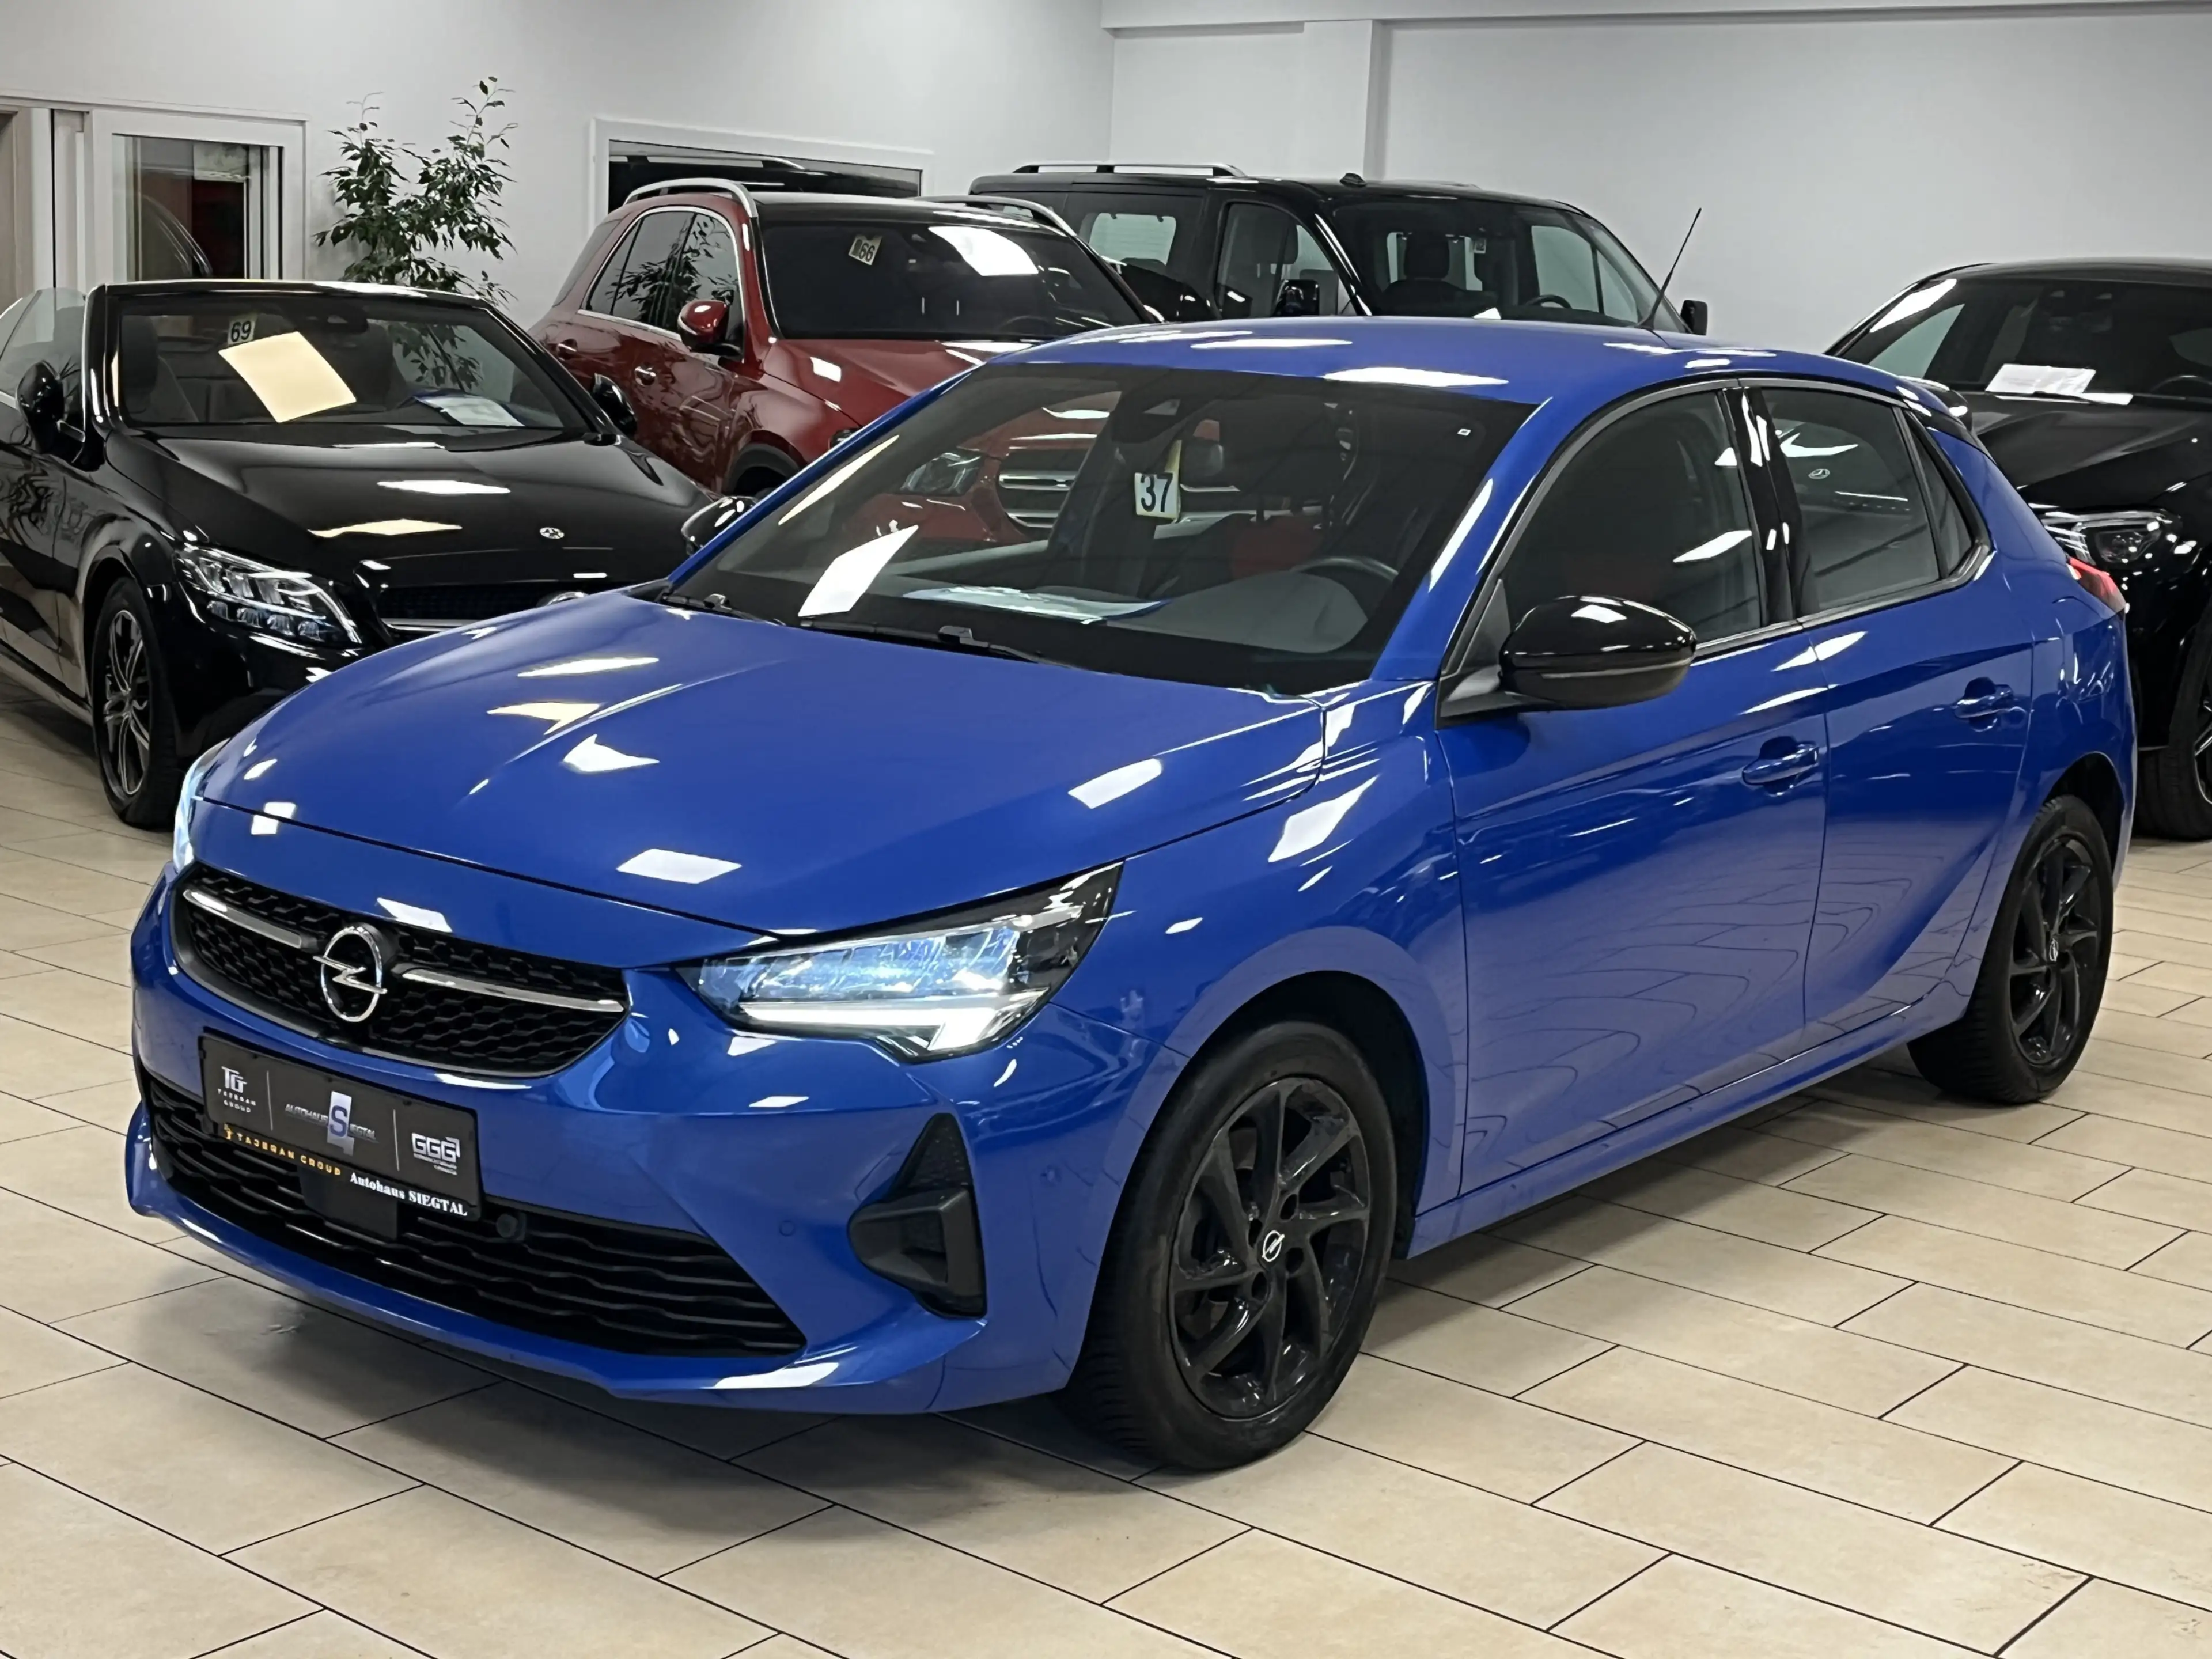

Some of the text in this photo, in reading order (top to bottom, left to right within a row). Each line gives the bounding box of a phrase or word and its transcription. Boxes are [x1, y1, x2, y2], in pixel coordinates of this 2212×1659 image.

[231, 320, 252, 342] 69
[1140, 472, 1173, 513] 37
[350, 1172, 468, 1217] Autohaus SIEGTAL
